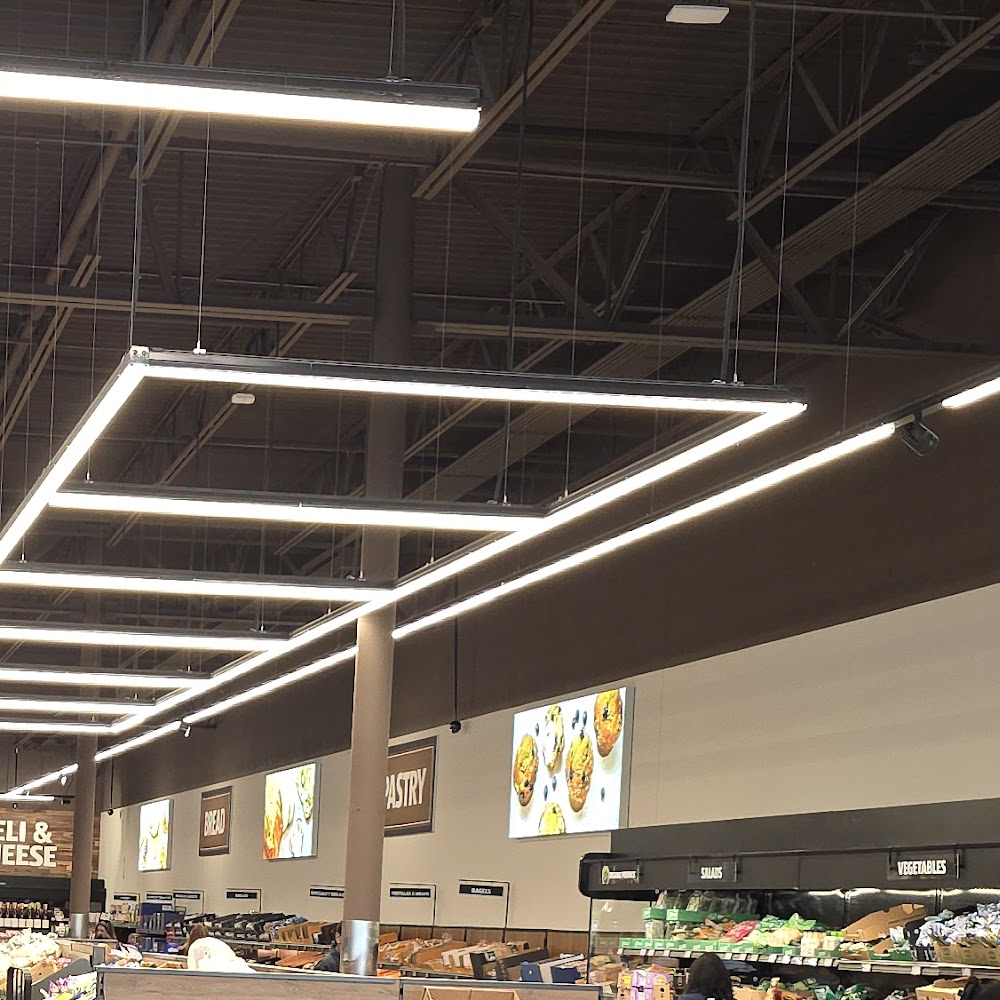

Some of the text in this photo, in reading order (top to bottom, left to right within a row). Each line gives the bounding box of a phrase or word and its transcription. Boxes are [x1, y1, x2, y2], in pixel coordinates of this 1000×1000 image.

[33, 821, 53, 844] &
[203, 807, 226, 837] BREAD
[897, 859, 947, 876] VEGETABLES
